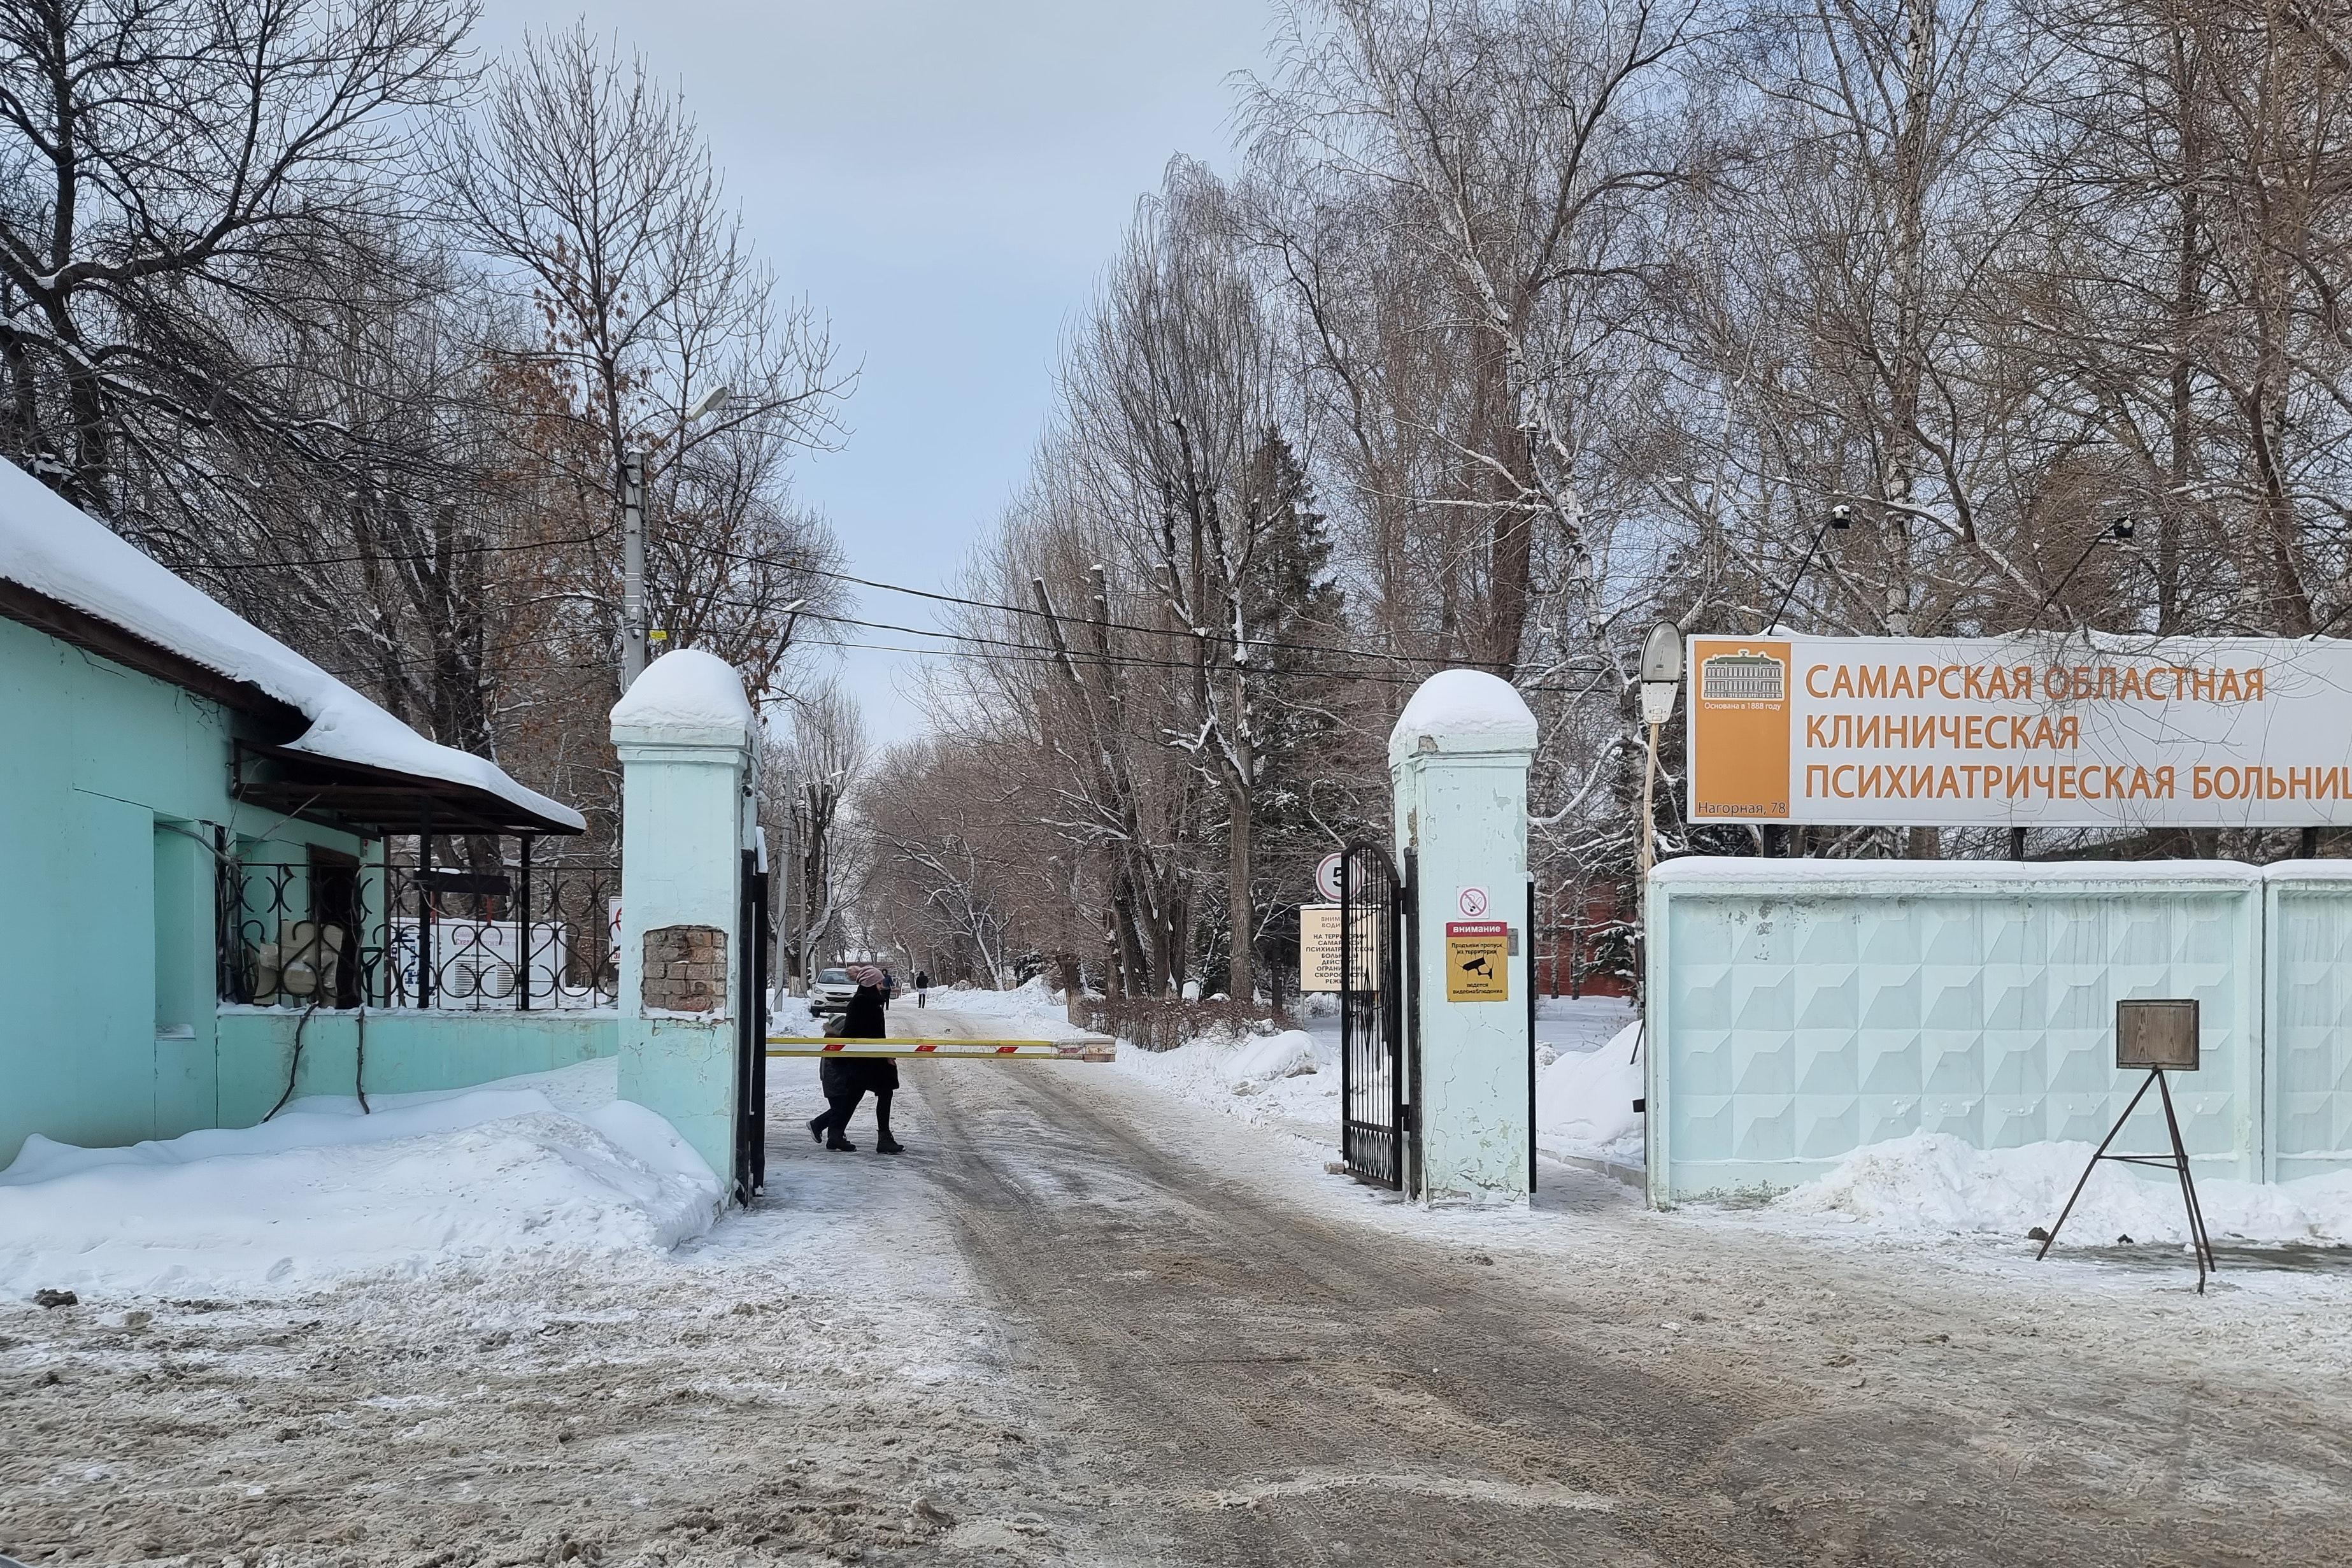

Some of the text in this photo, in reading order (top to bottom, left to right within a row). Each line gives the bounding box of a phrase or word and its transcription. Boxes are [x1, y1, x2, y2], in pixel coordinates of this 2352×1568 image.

[1806, 664, 2263, 701] САМАРСКАЯ ОБЛАСТНАЯ
[1765, 703, 1781, 711] году
[1806, 715, 2079, 750] КЛИНИЧЕСКАЯ
[1806, 764, 2174, 799] ПСИХИАТРИЧЕСКАЯ
[1698, 802, 1786, 816] Нагорная, 78
